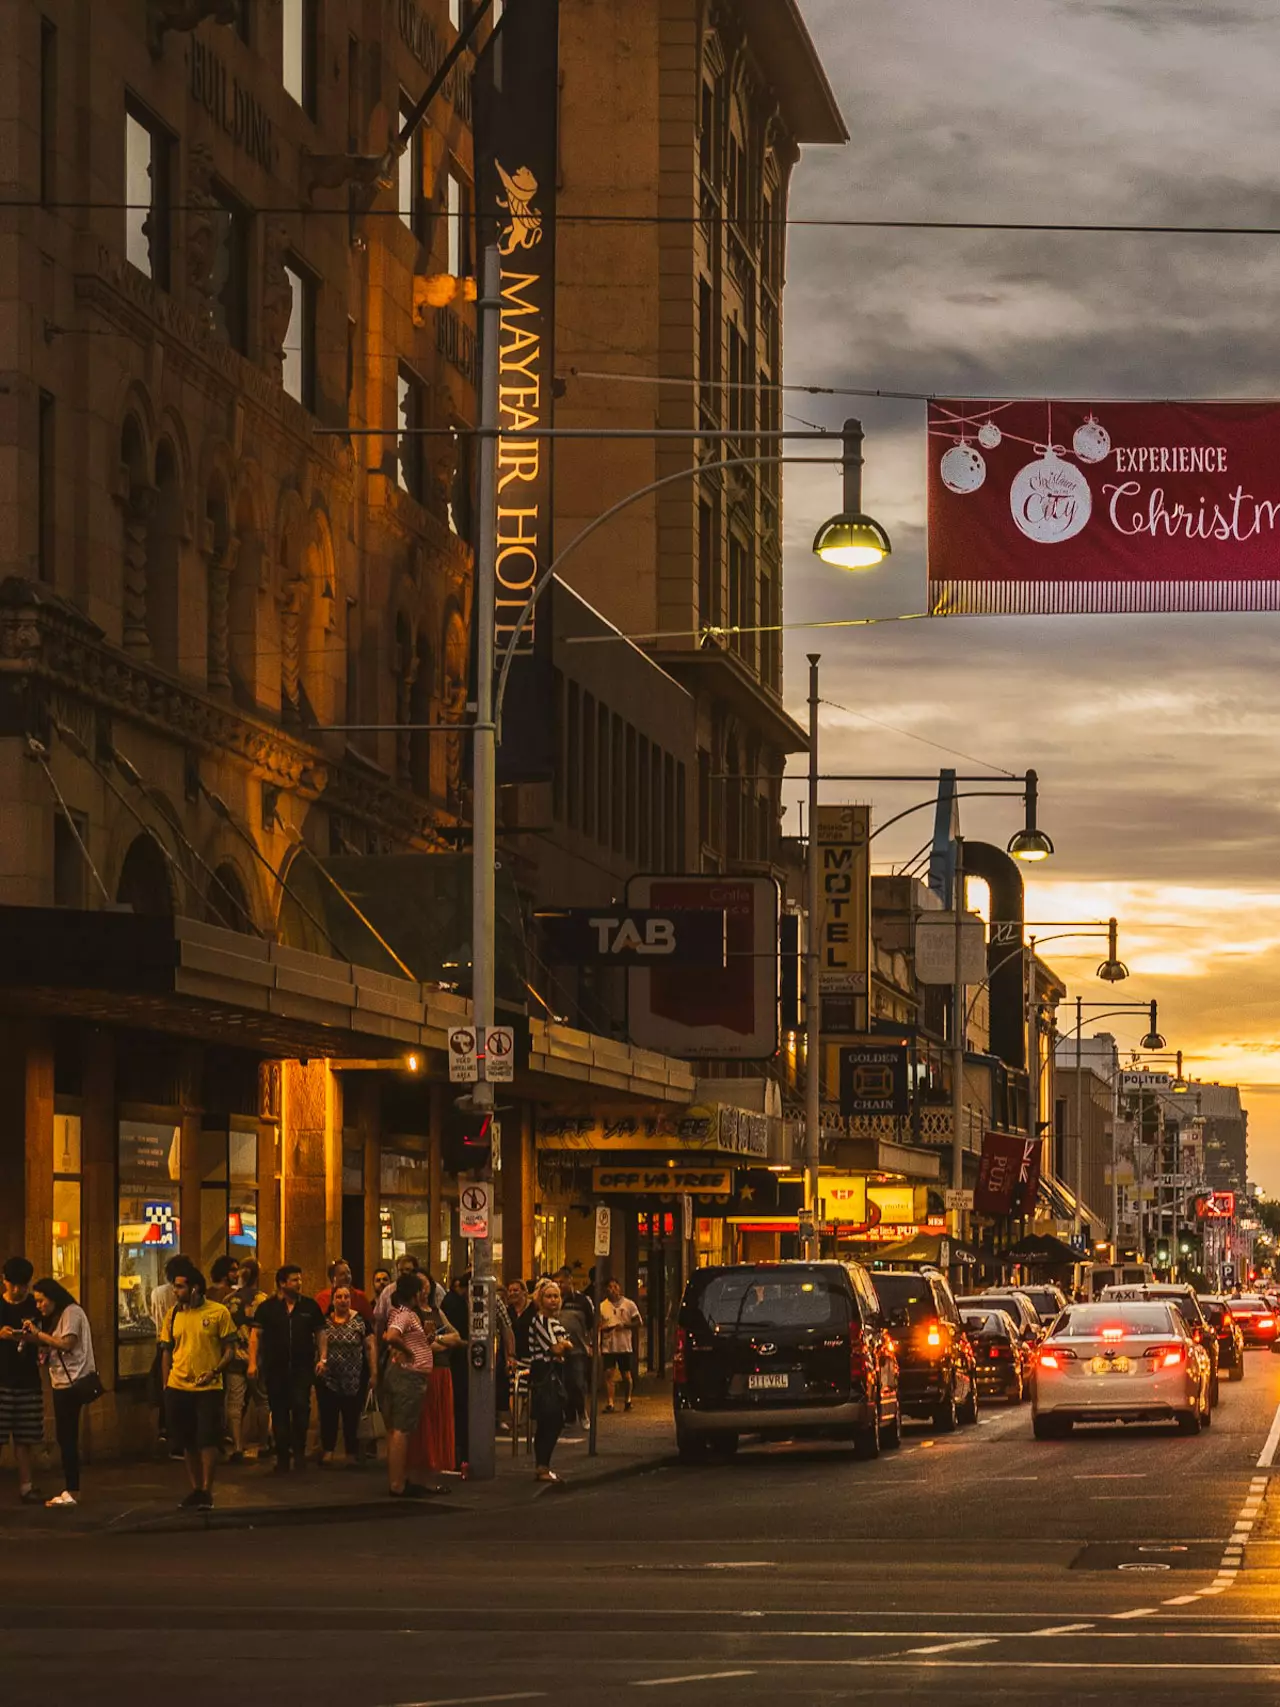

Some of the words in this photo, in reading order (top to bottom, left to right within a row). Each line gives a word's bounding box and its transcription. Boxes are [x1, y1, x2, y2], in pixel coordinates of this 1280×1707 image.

[498, 268, 541, 495] MAYFAIR
[1116, 447, 1228, 473] EXPERIENCE
[824, 849, 853, 968] MOTEL
[588, 918, 676, 955] TAB
[848, 1053, 899, 1064] GOLDEN
[1124, 1075, 1169, 1084] POLITES
[853, 1100, 894, 1110] CHAIN
[599, 1173, 639, 1187] OFF
[643, 1173, 671, 1188] YA
[674, 1173, 725, 1188] TREE
[989, 1154, 1007, 1192] PUB
[1109, 1291, 1135, 1299] TAXI
